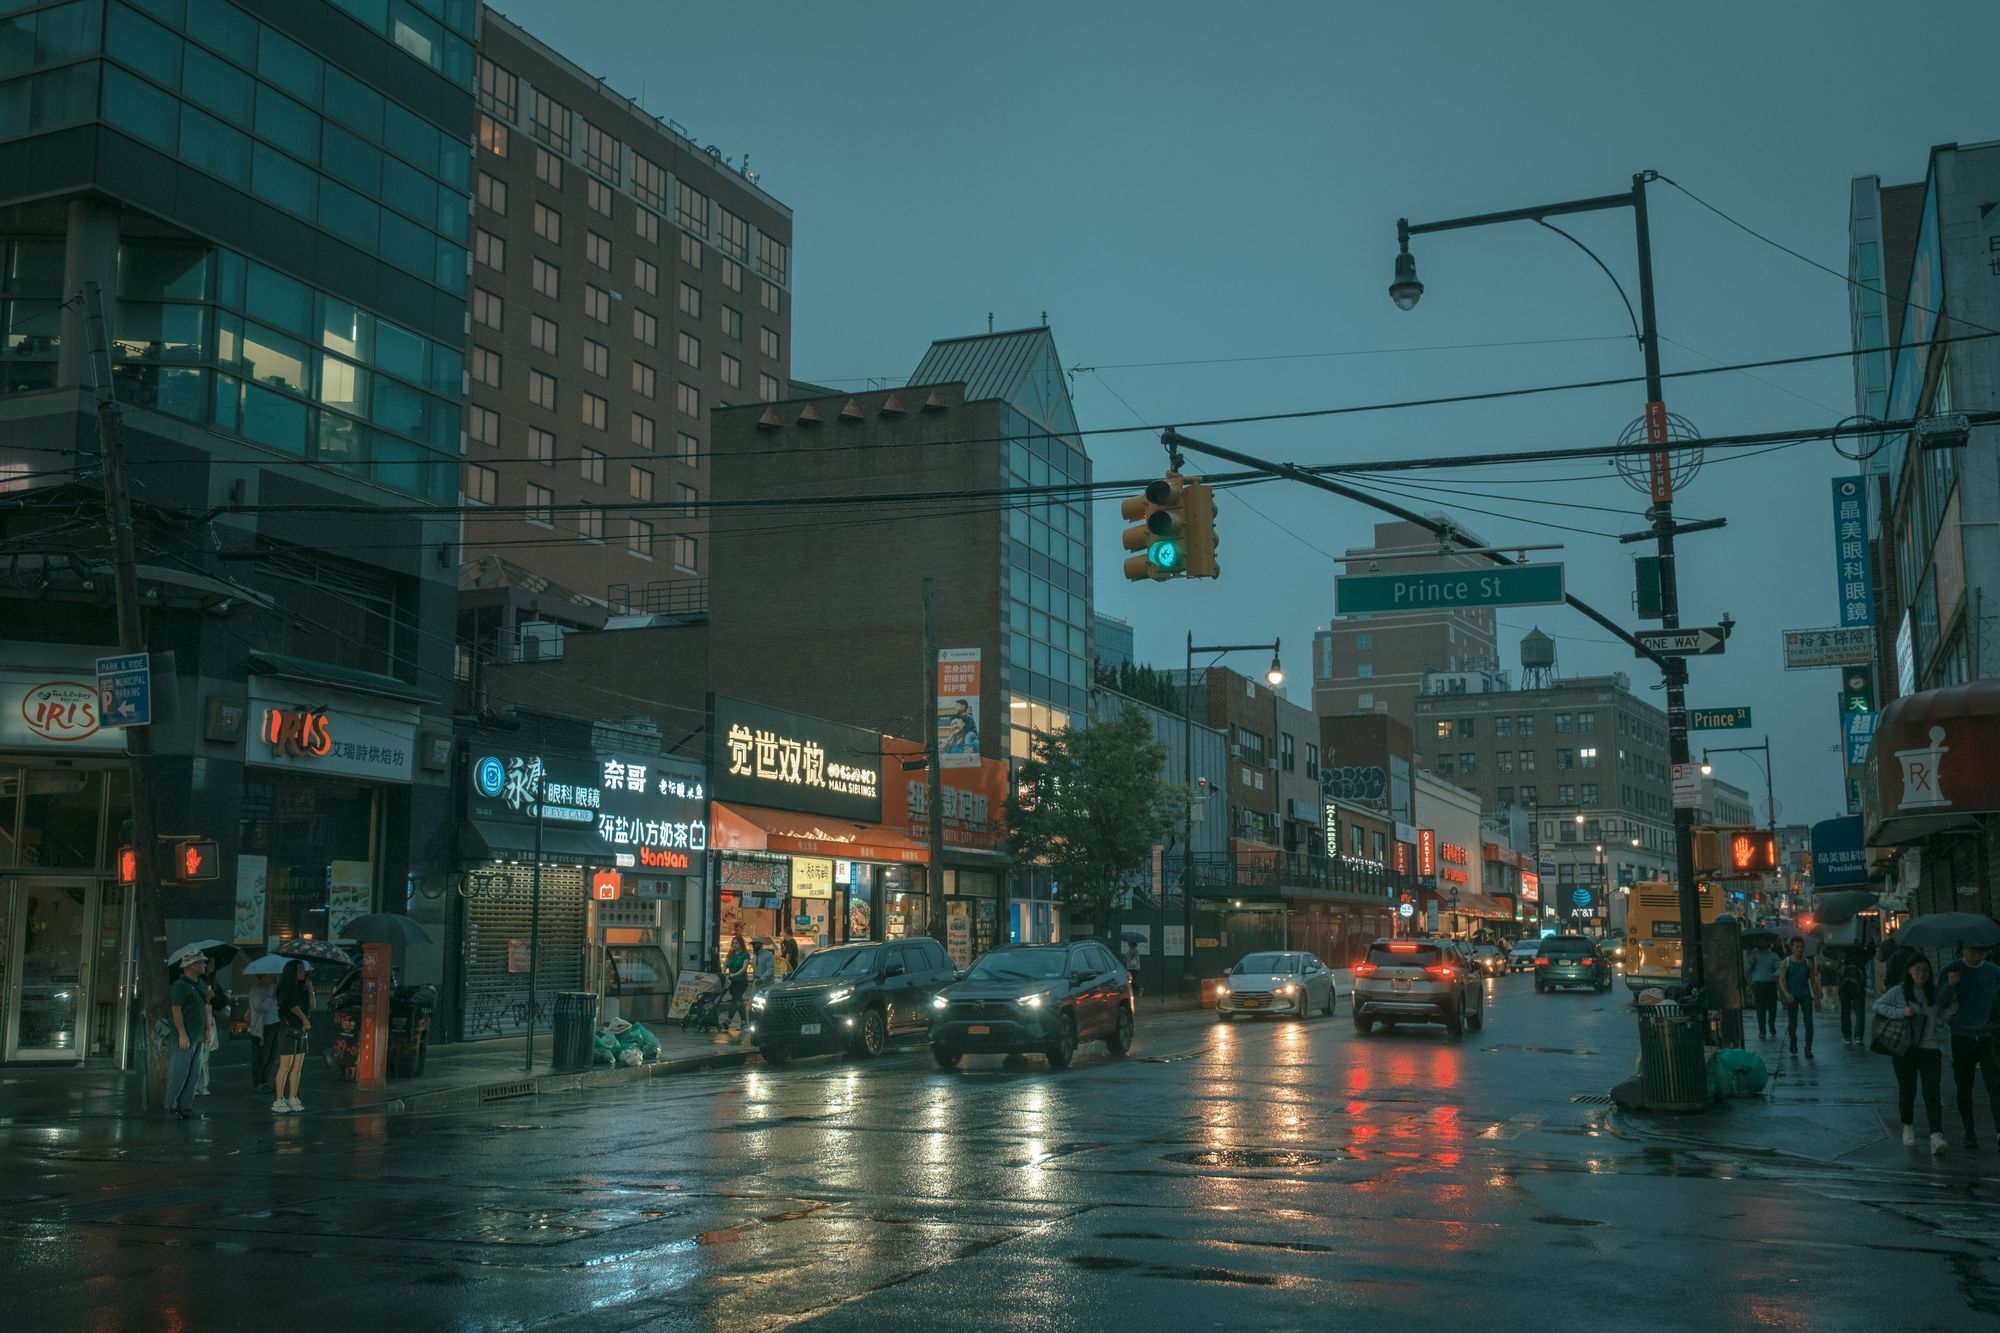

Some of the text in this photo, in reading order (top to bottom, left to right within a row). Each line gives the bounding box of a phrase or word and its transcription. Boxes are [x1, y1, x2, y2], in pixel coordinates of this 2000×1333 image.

[1651, 406, 1666, 497] FLUHING
[1840, 501, 1868, 621] 晶美眼科眼鏡
[1394, 577, 1502, 602] Prince St
[1644, 636, 1700, 649] ONE WAY
[101, 663, 119, 672] PARK
[128, 659, 143, 669] RIDE
[114, 675, 146, 687] MUNICIPAL
[102, 691, 113, 714] P
[115, 688, 141, 699] PARKING
[37, 703, 96, 731] IRIS
[1694, 708, 1746, 728] Prince St
[262, 708, 333, 758] IRIS
[331, 742, 405, 767] 艾瑞詩烘焙坊
[604, 759, 647, 793] 奈哥
[828, 779, 848, 793] MALA
[548, 783, 600, 808] 眼科 眼鏡
[551, 808, 567, 818] EYE
[568, 809, 591, 820] CARE
[1827, 863, 1863, 873] Precision
[1571, 908, 1594, 918] AT&T
